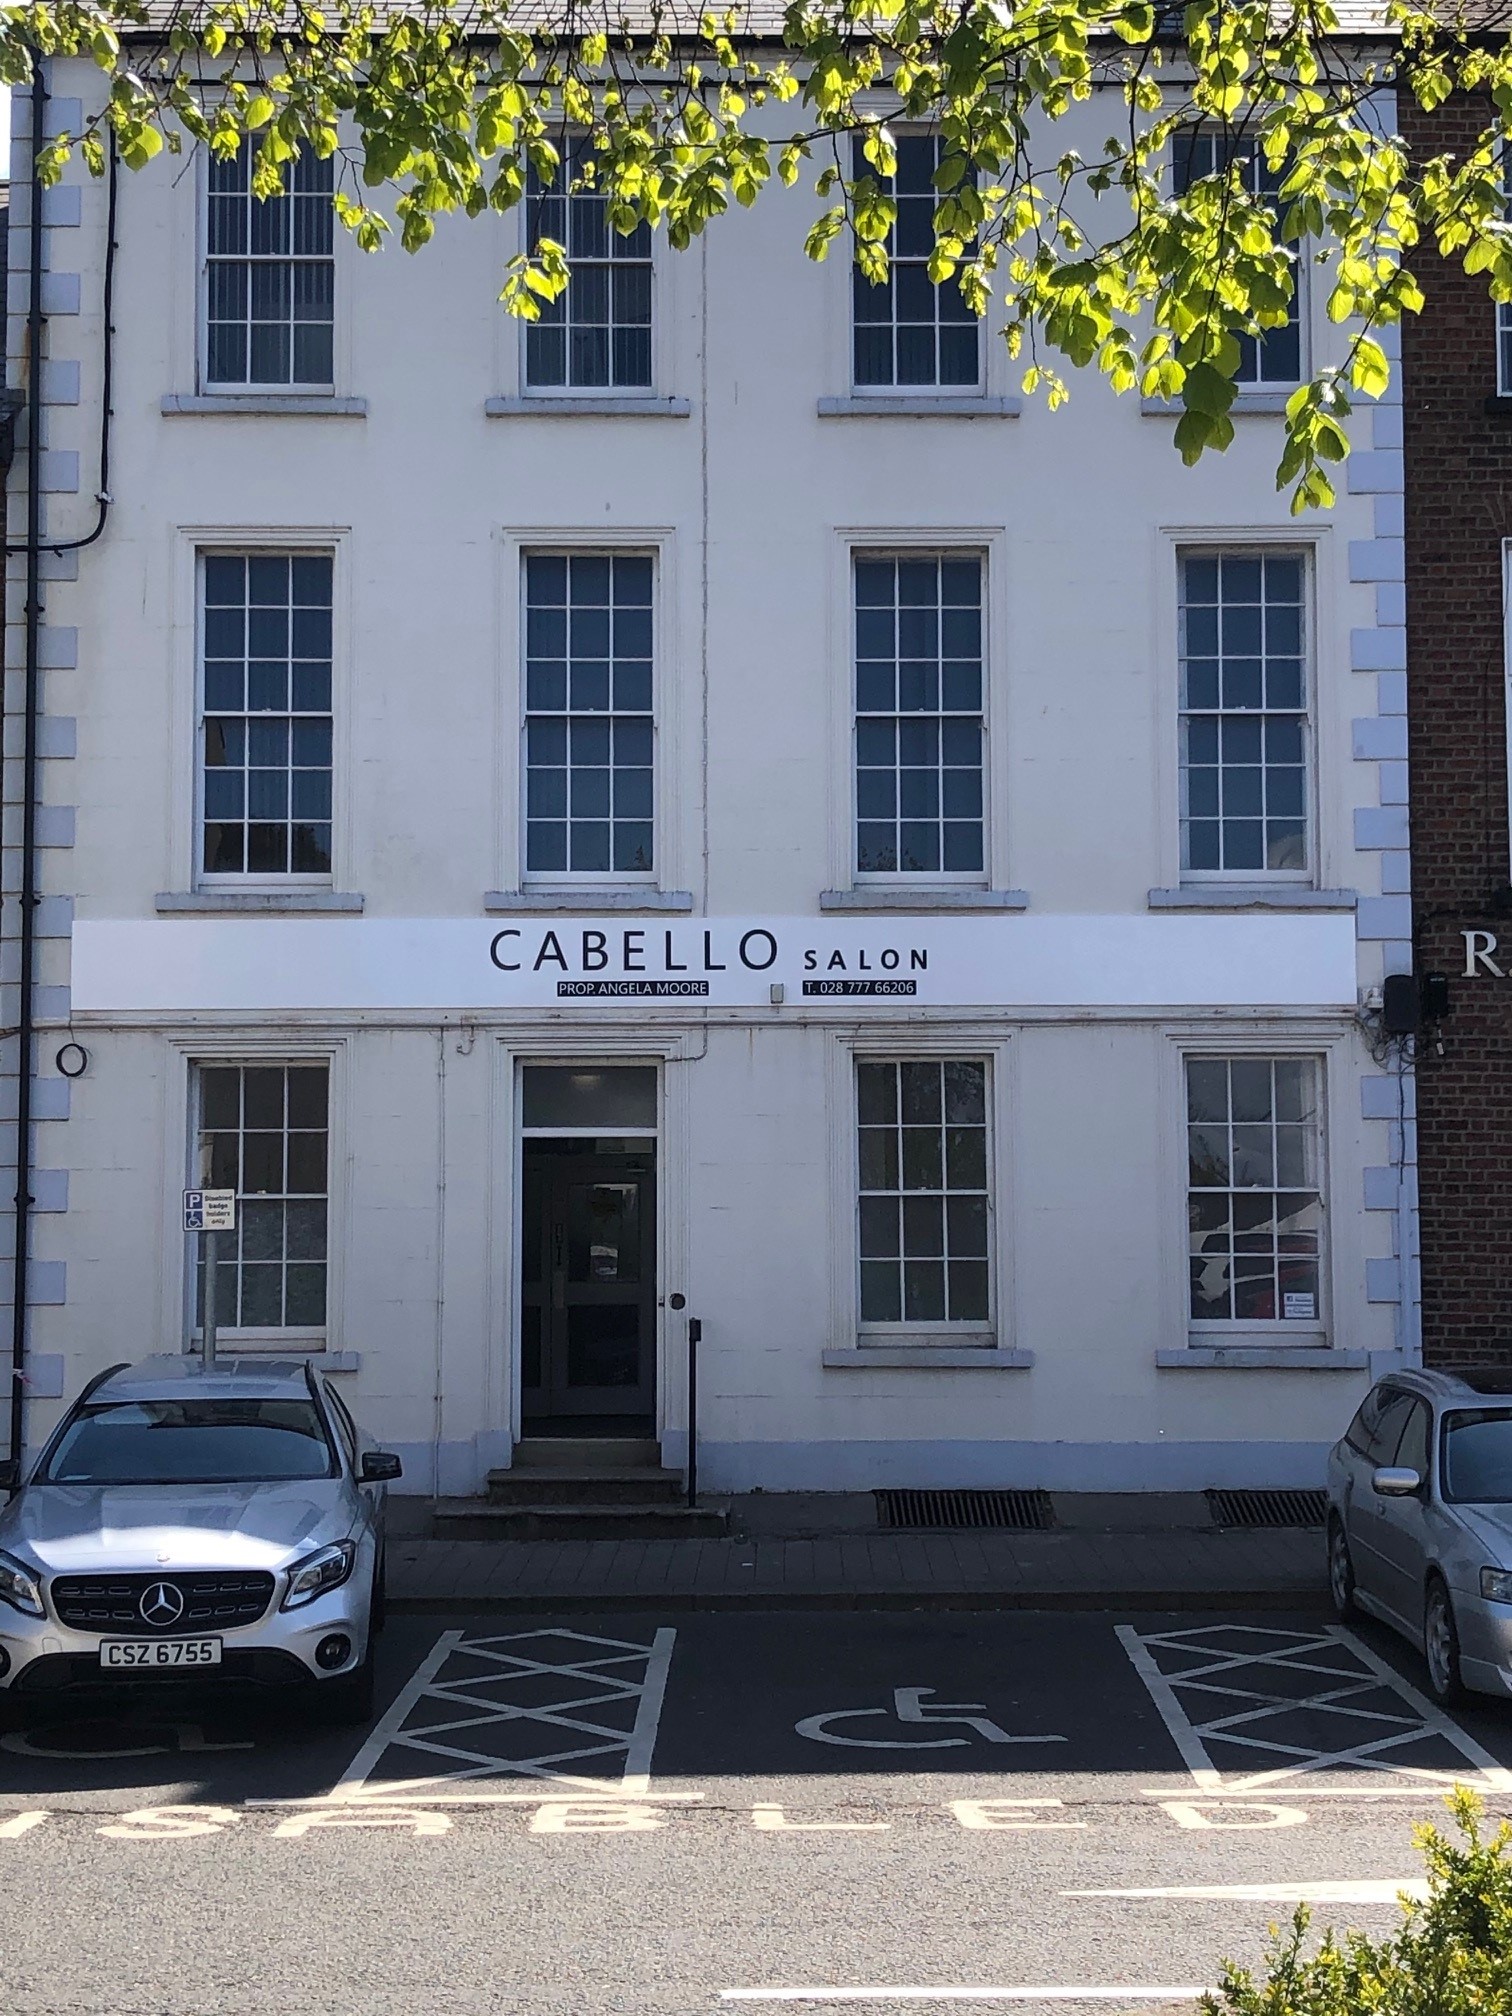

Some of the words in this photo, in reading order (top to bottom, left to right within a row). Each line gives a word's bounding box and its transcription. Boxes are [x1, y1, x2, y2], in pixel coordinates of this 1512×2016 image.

[489, 928, 778, 972] CABELLO
[804, 949, 928, 970] SALON
[558, 983, 596, 995] PROP.
[599, 983, 652, 995] ANGELA
[656, 982, 707, 995] MOORE
[805, 982, 817, 994] T.
[820, 982, 843, 993] 028
[847, 982, 871, 993] 777
[874, 982, 914, 993] 66206
[189, 1195, 200, 1208] P
[108, 1645, 150, 1665] CSZ
[156, 1642, 212, 1663] 6755
